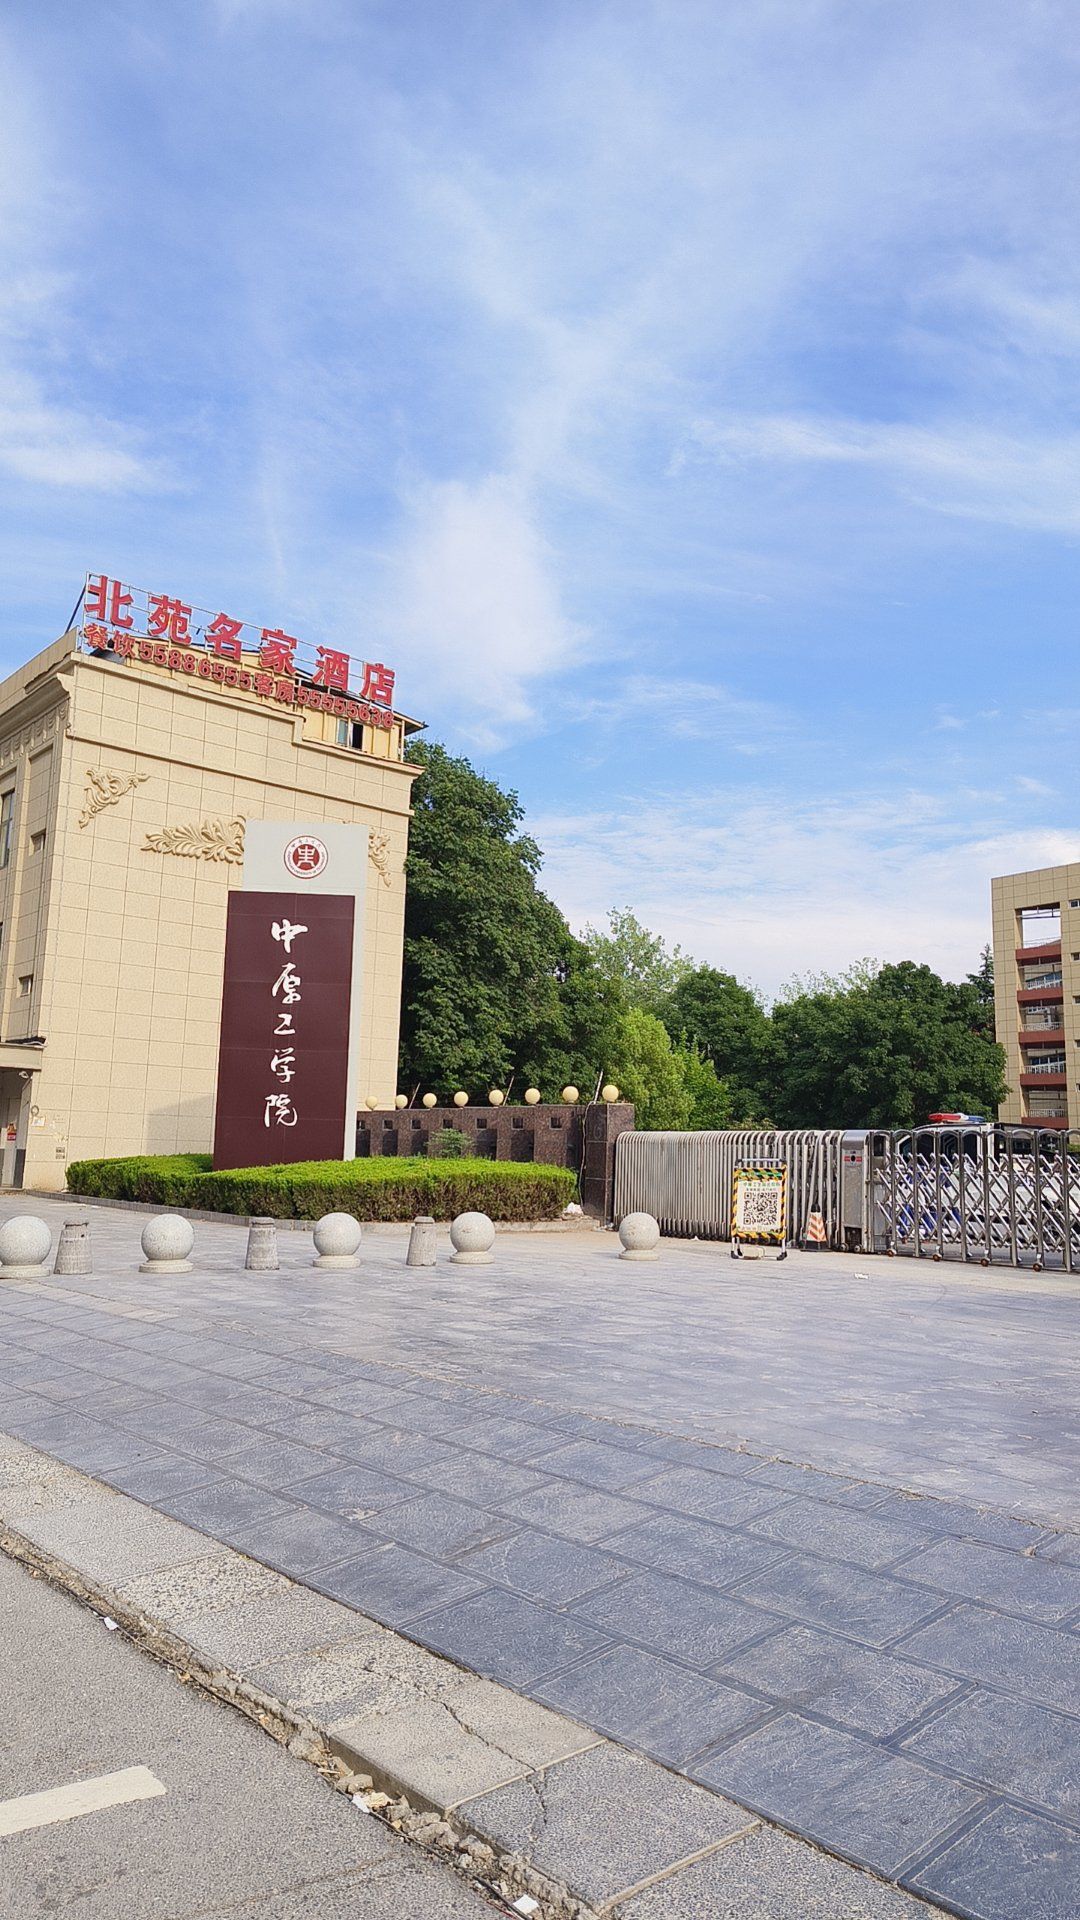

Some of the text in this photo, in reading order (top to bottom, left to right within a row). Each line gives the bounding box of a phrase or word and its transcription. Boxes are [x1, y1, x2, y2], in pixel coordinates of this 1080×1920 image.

[84, 575, 396, 705] 北苑名家酒店
[264, 919, 308, 1128] 中原工学院
